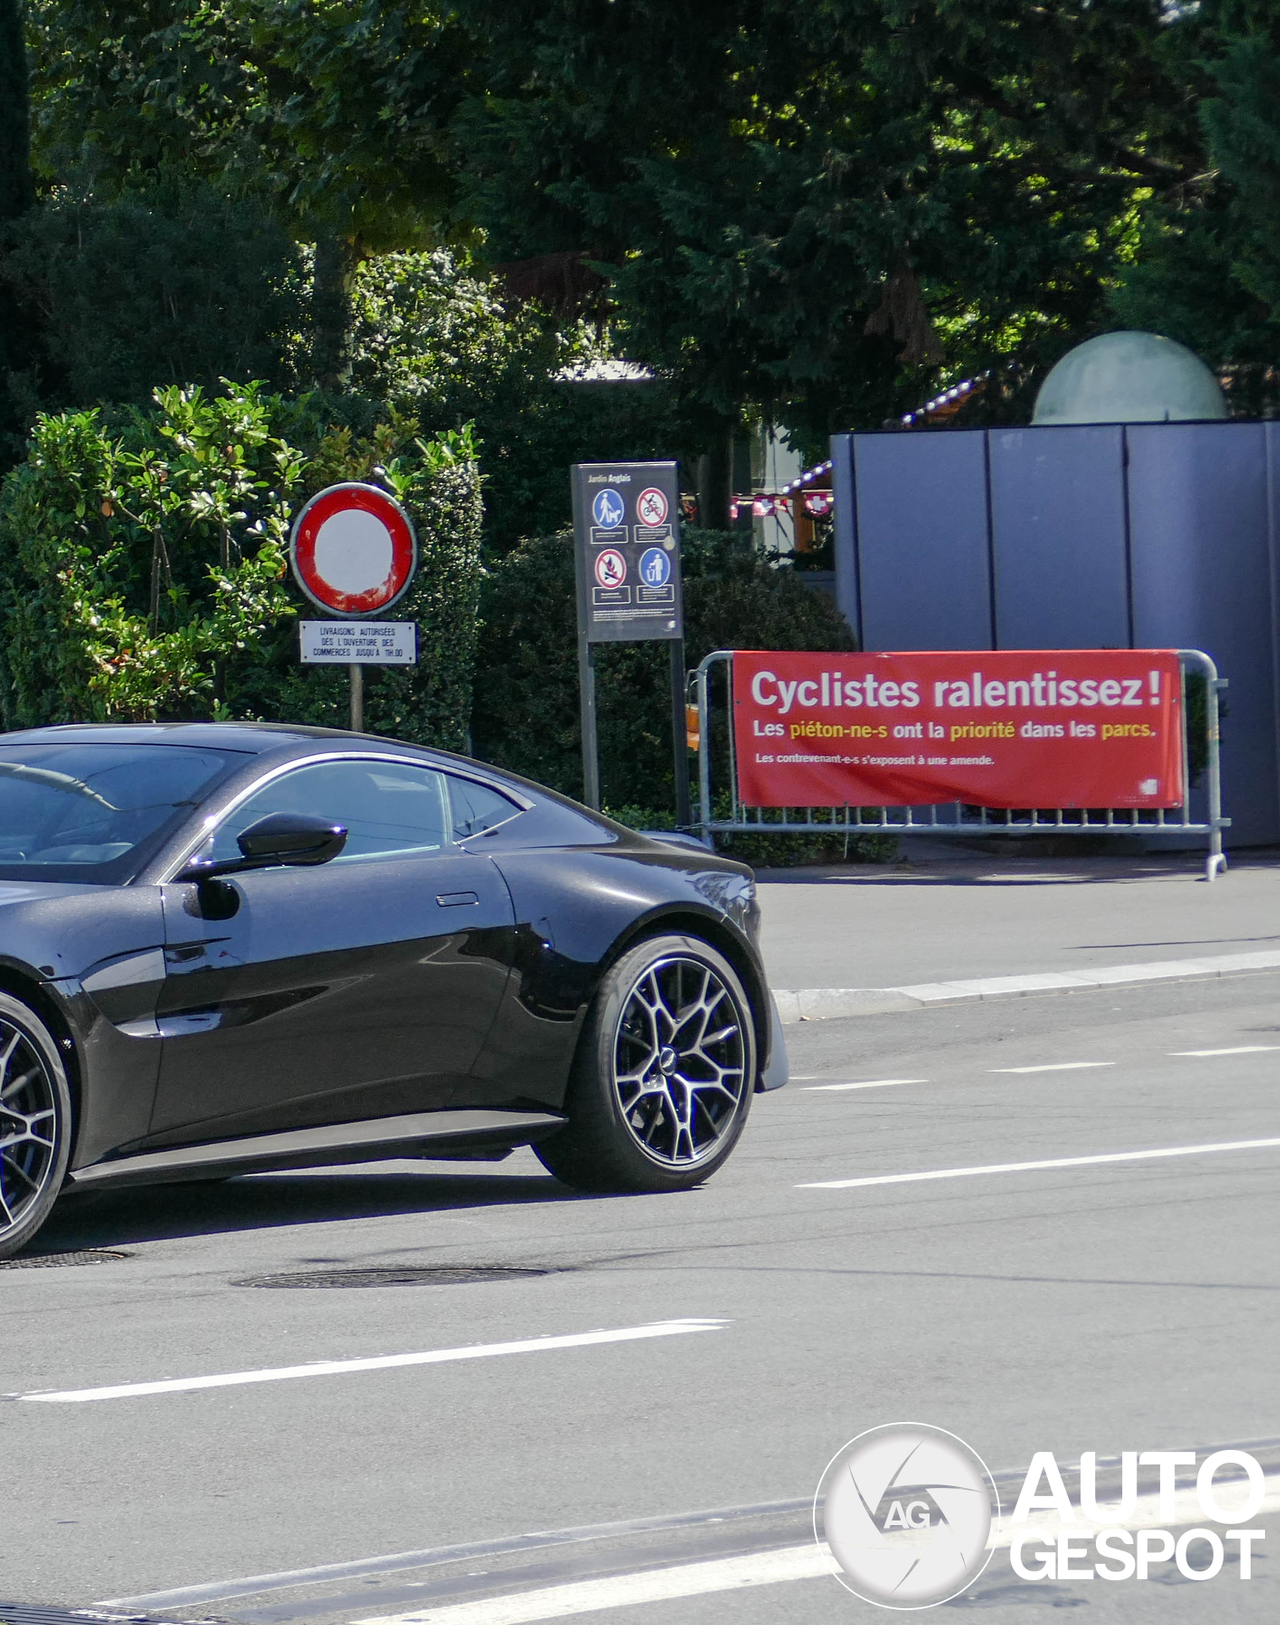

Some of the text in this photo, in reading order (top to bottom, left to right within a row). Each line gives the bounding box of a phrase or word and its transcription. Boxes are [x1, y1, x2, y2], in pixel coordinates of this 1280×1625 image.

[608, 474, 631, 484] Anglais
[320, 626, 396, 636] LIVRAISONS AUTORISÉES
[382, 639, 394, 647] DES
[313, 648, 351, 657] COMMERCES
[751, 671, 920, 714] Cyclistes
[753, 720, 1156, 742] Les piéton-ne-s ont la priorité dans les parcs.
[755, 753, 774, 763] Les
[862, 755, 916, 766] s'exposent
[918, 754, 926, 765] à
[927, 757, 947, 765] une
[950, 755, 995, 765] amende.
